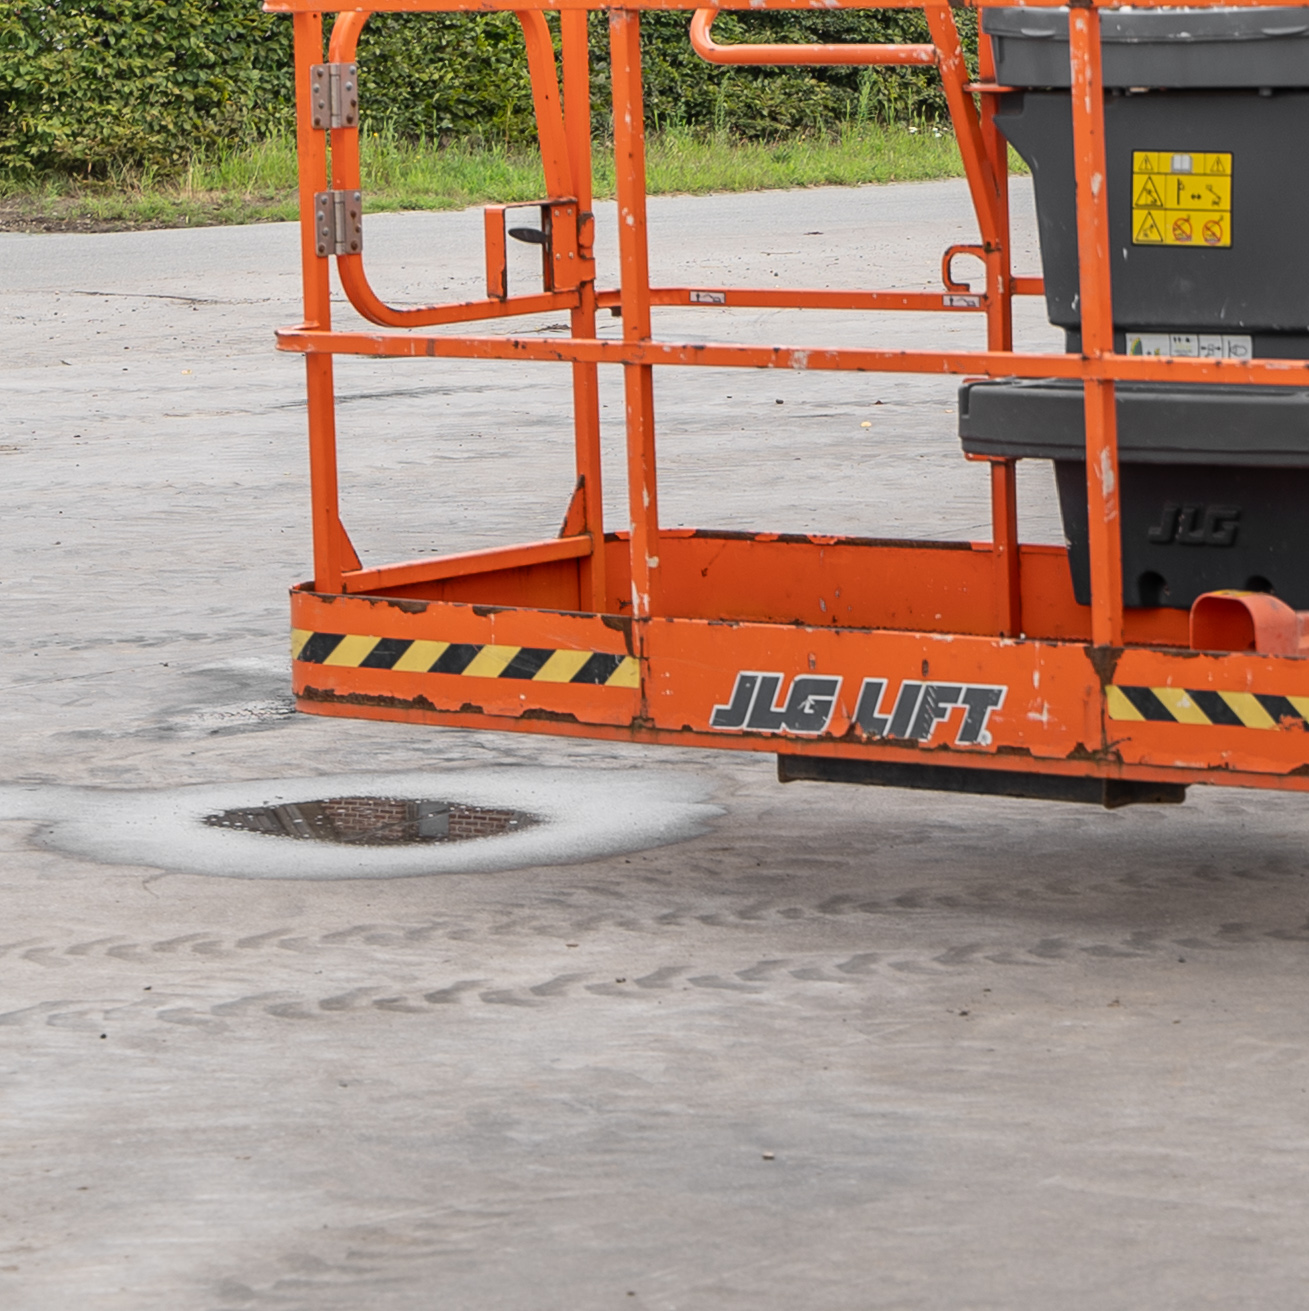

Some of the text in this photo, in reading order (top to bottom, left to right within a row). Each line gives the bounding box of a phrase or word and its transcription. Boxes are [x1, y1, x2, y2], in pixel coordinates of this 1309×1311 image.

[1148, 503, 1241, 547] JLG
[709, 671, 1007, 745] JLG LIFT
